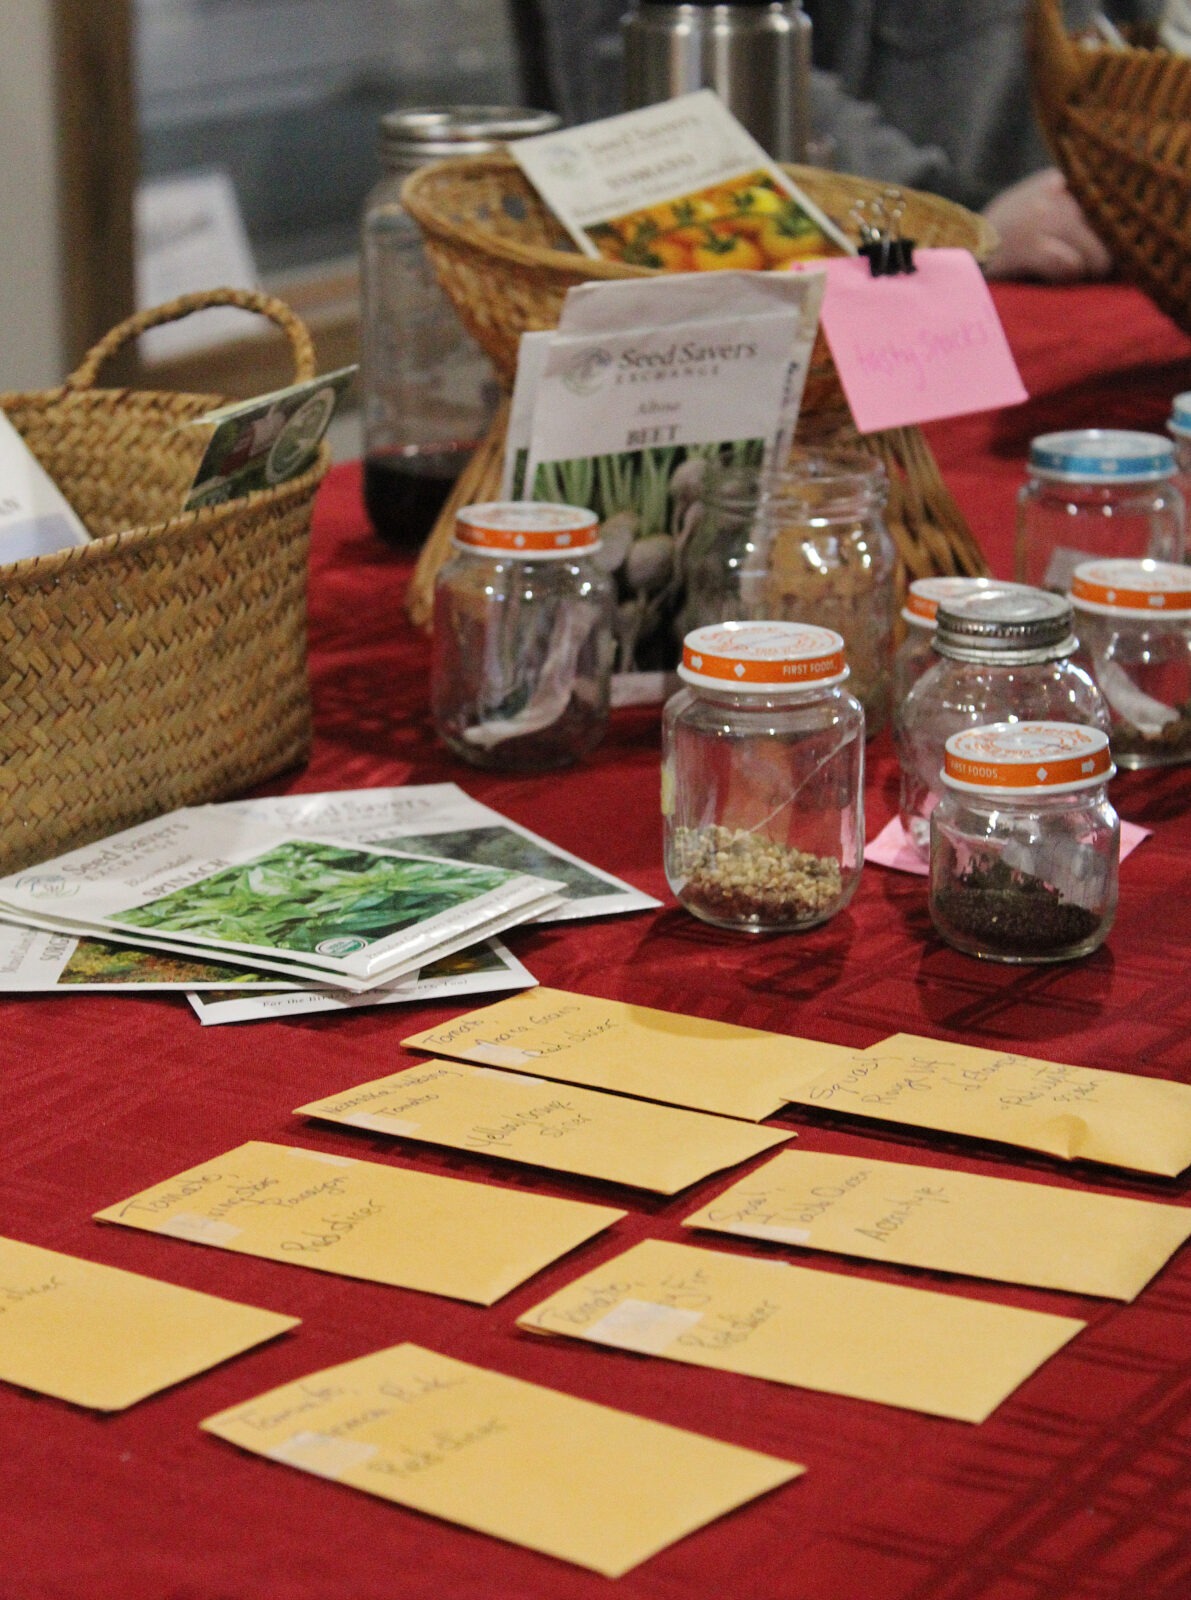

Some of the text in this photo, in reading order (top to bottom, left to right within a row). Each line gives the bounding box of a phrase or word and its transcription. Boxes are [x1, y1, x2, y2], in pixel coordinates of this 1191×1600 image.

[619, 342, 758, 369] Seed Savers
[627, 424, 679, 447] BEET
[783, 660, 837, 676] FIRST FOODS
[968, 764, 998, 779] FOODS
[62, 822, 190, 877] Seed Savers
[142, 857, 231, 897] SPINACH
[263, 999, 282, 1009] For
[287, 997, 304, 1006] the
